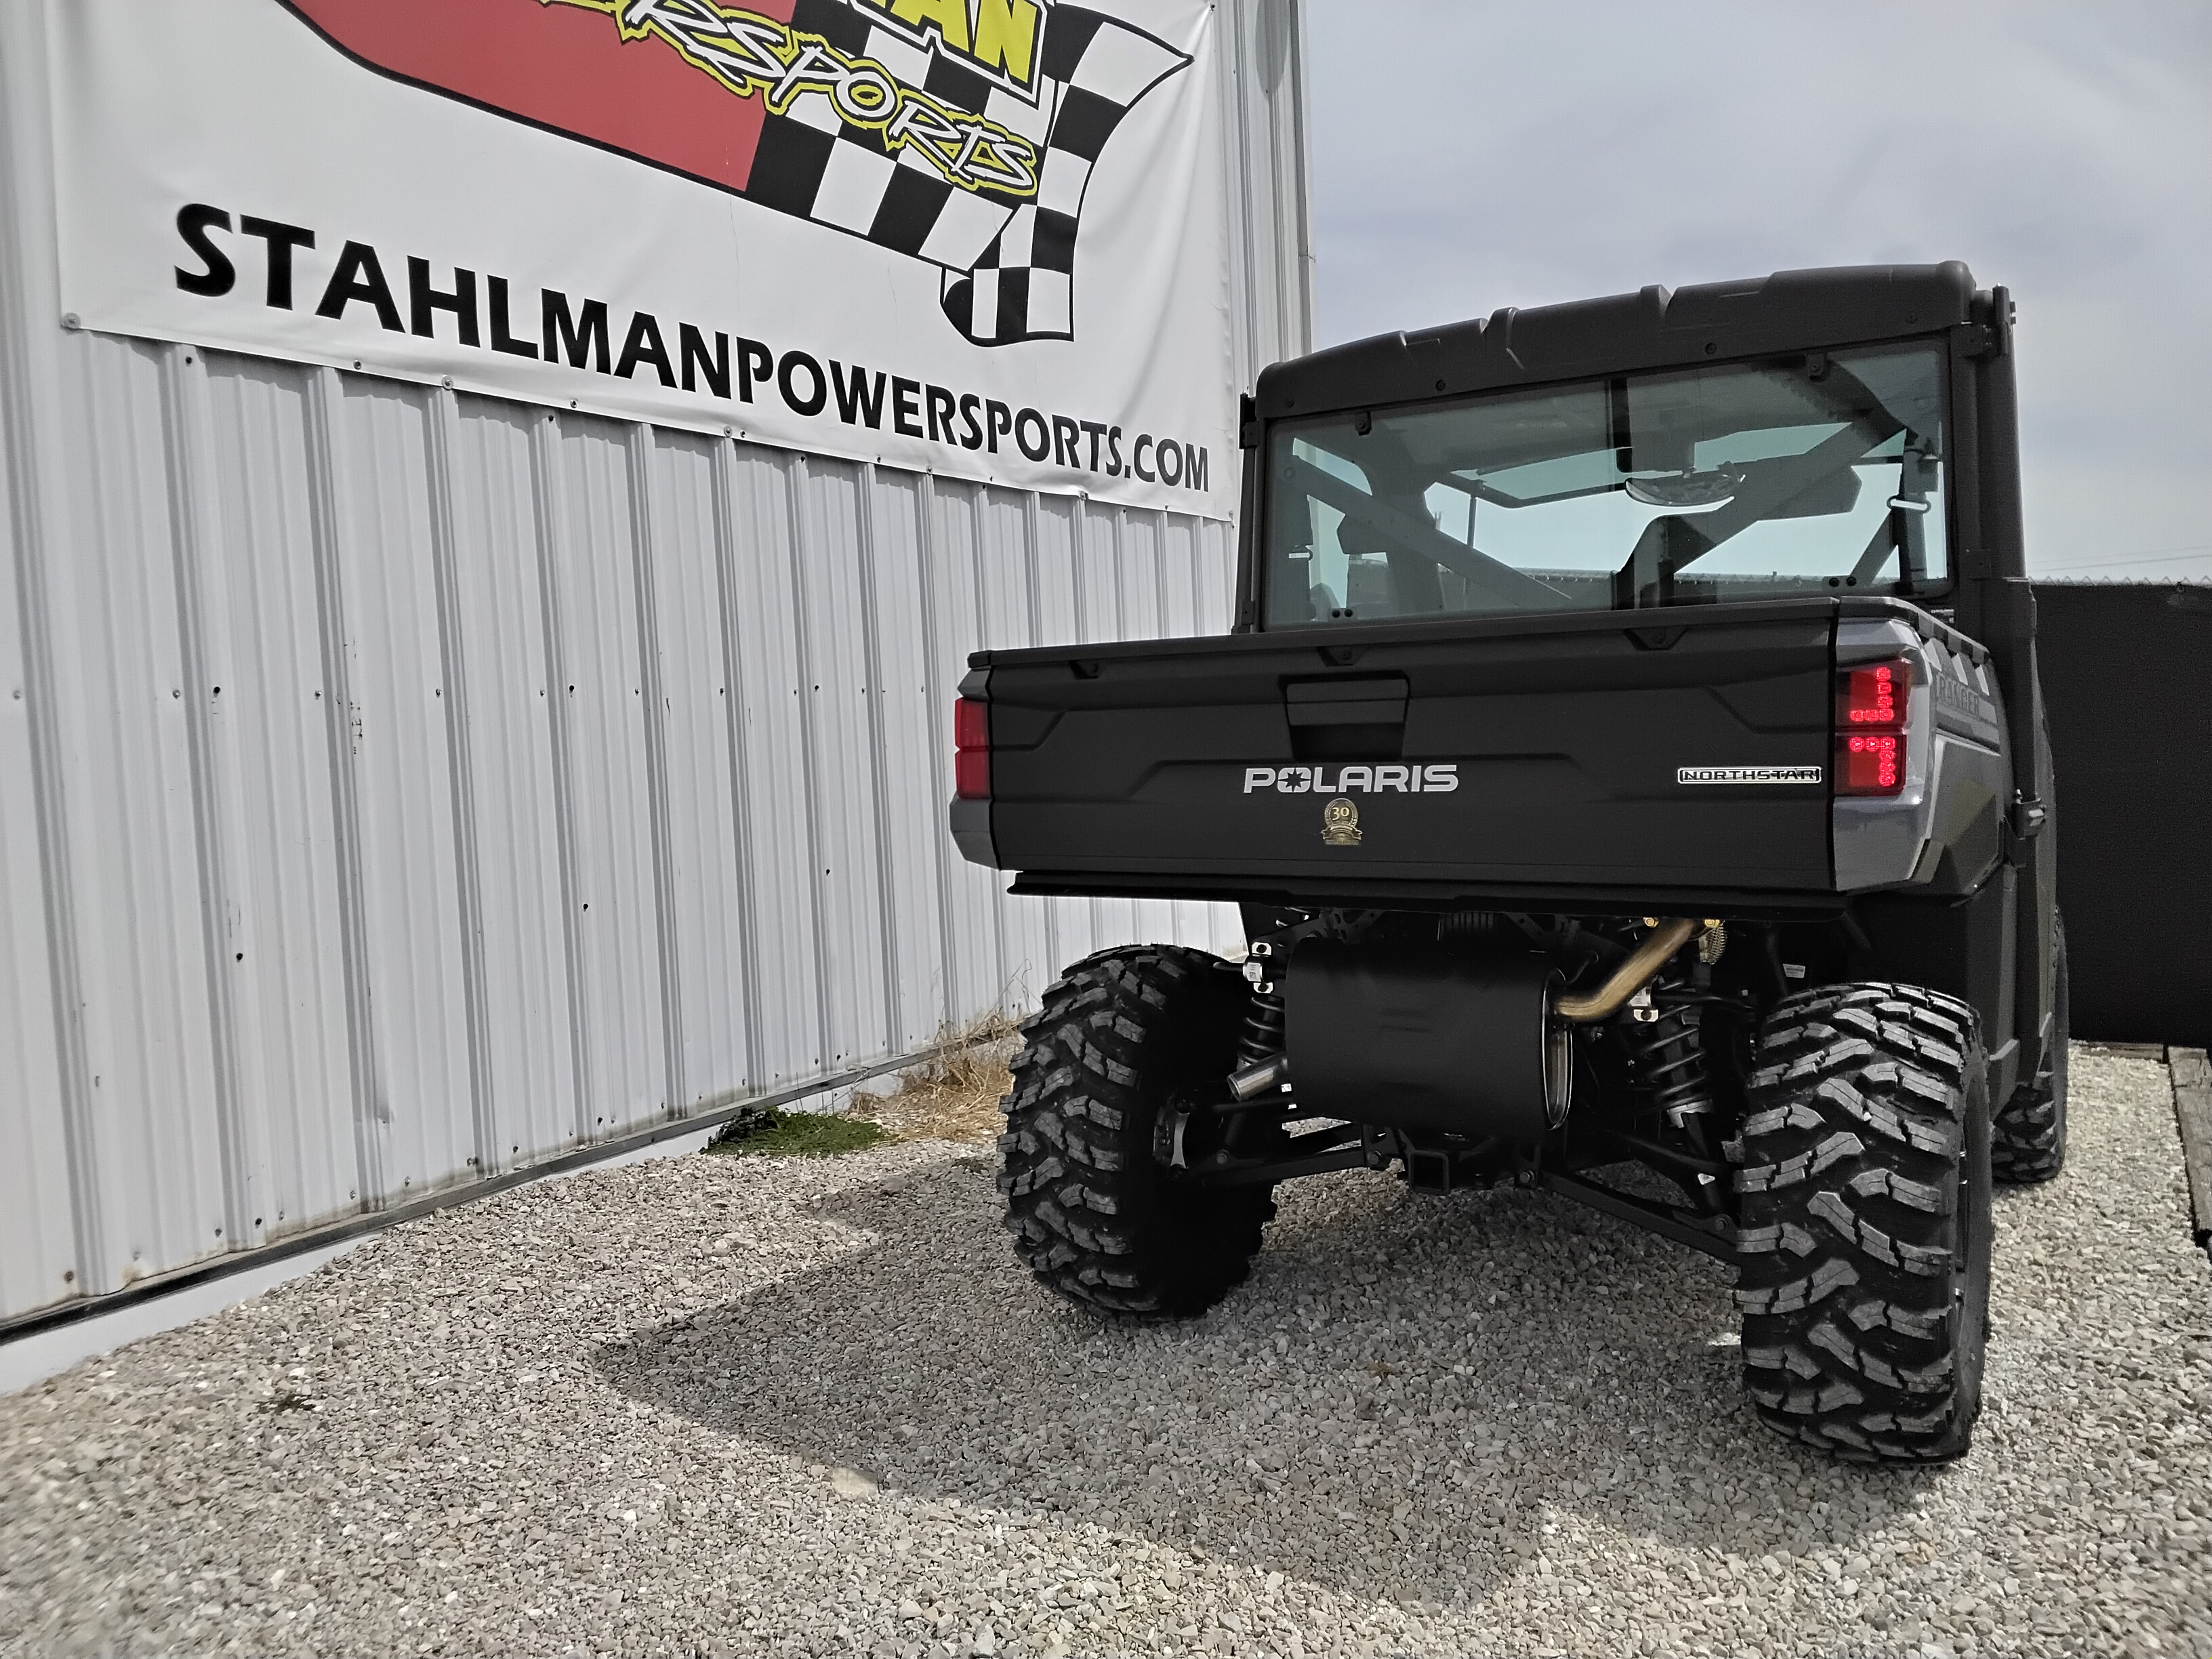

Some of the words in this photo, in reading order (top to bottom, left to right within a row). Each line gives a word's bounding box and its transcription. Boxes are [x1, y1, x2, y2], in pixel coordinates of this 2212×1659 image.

[873, 0, 1038, 83] AN
[173, 203, 1209, 493] STAHLMANPOWERSPORTS.COM
[1939, 674, 1980, 717] RANGER
[1244, 764, 1458, 793] POLARIS
[1683, 769, 1815, 781] NORTHSTAR
[1332, 807, 1349, 821] 30
